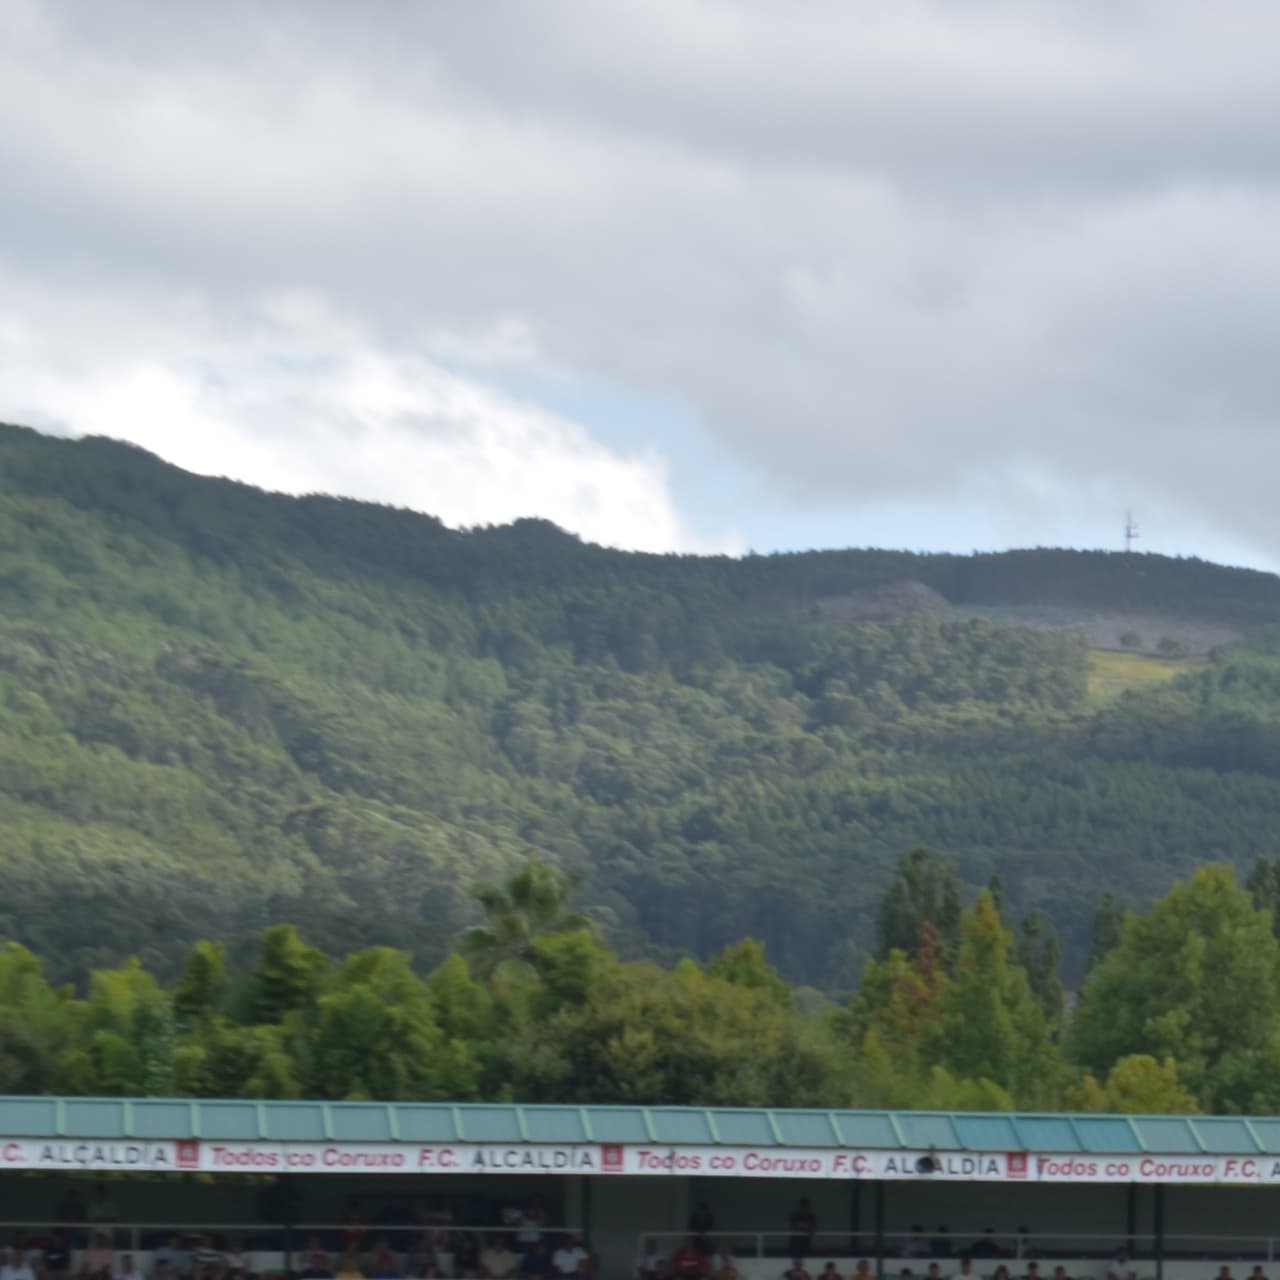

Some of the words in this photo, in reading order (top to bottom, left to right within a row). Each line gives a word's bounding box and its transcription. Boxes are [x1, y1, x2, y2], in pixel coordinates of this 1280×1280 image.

[211, 1146, 279, 1167] Todos
[287, 1152, 316, 1167] co
[322, 1148, 405, 1168] Coruxo
[417, 1148, 460, 1168] F.C.
[470, 1145, 594, 1169] ALCALDÍA
[636, 1151, 701, 1170] Todos
[709, 1156, 736, 1170] co
[744, 1153, 822, 1173] Coruxo
[832, 1154, 874, 1174] F.C.
[884, 1153, 1000, 1176] ALALDÍA
[1039, 1158, 1098, 1177] Todos
[1105, 1163, 1130, 1177] co
[1139, 1159, 1215, 1179] Coruxo
[1224, 1160, 1262, 1180] F.C.
